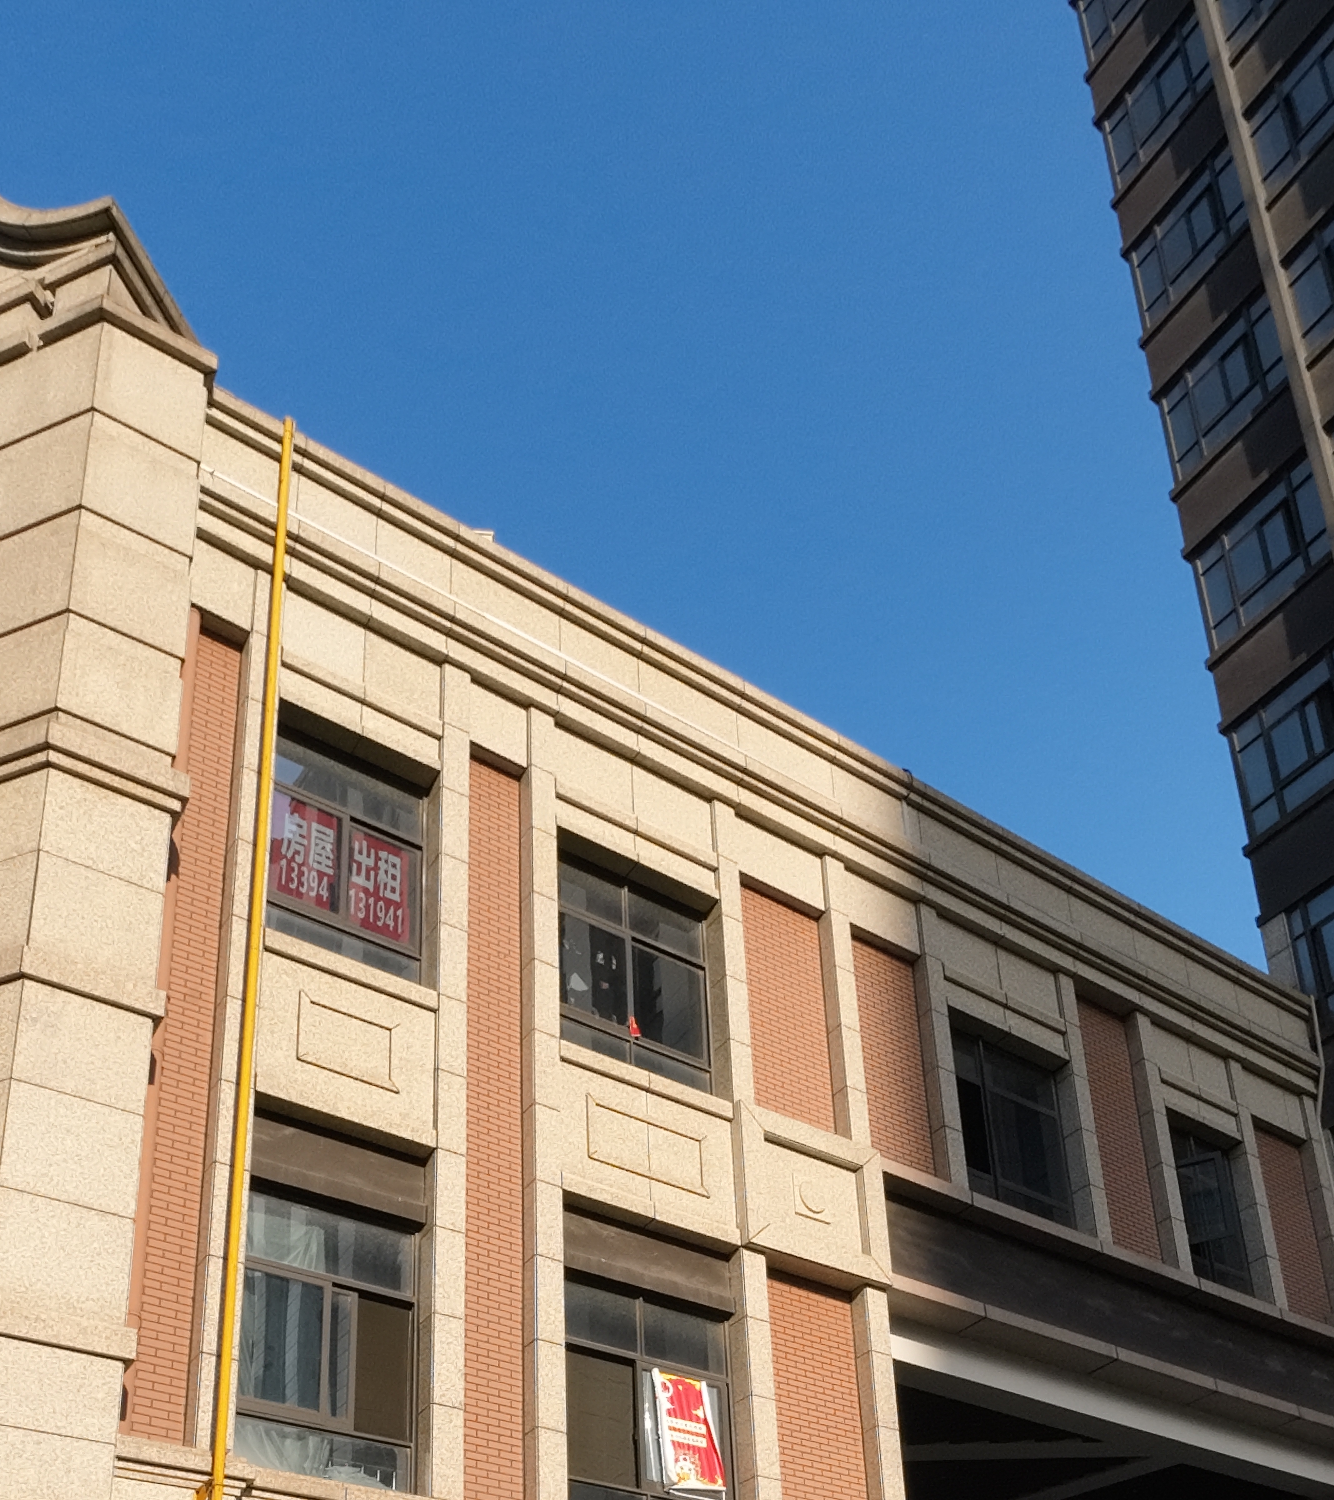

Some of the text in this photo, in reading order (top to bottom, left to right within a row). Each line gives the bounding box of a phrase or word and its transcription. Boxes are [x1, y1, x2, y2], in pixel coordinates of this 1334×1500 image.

[279, 859, 404, 934] 13394 131941
[281, 812, 402, 903] 房屋 出租
